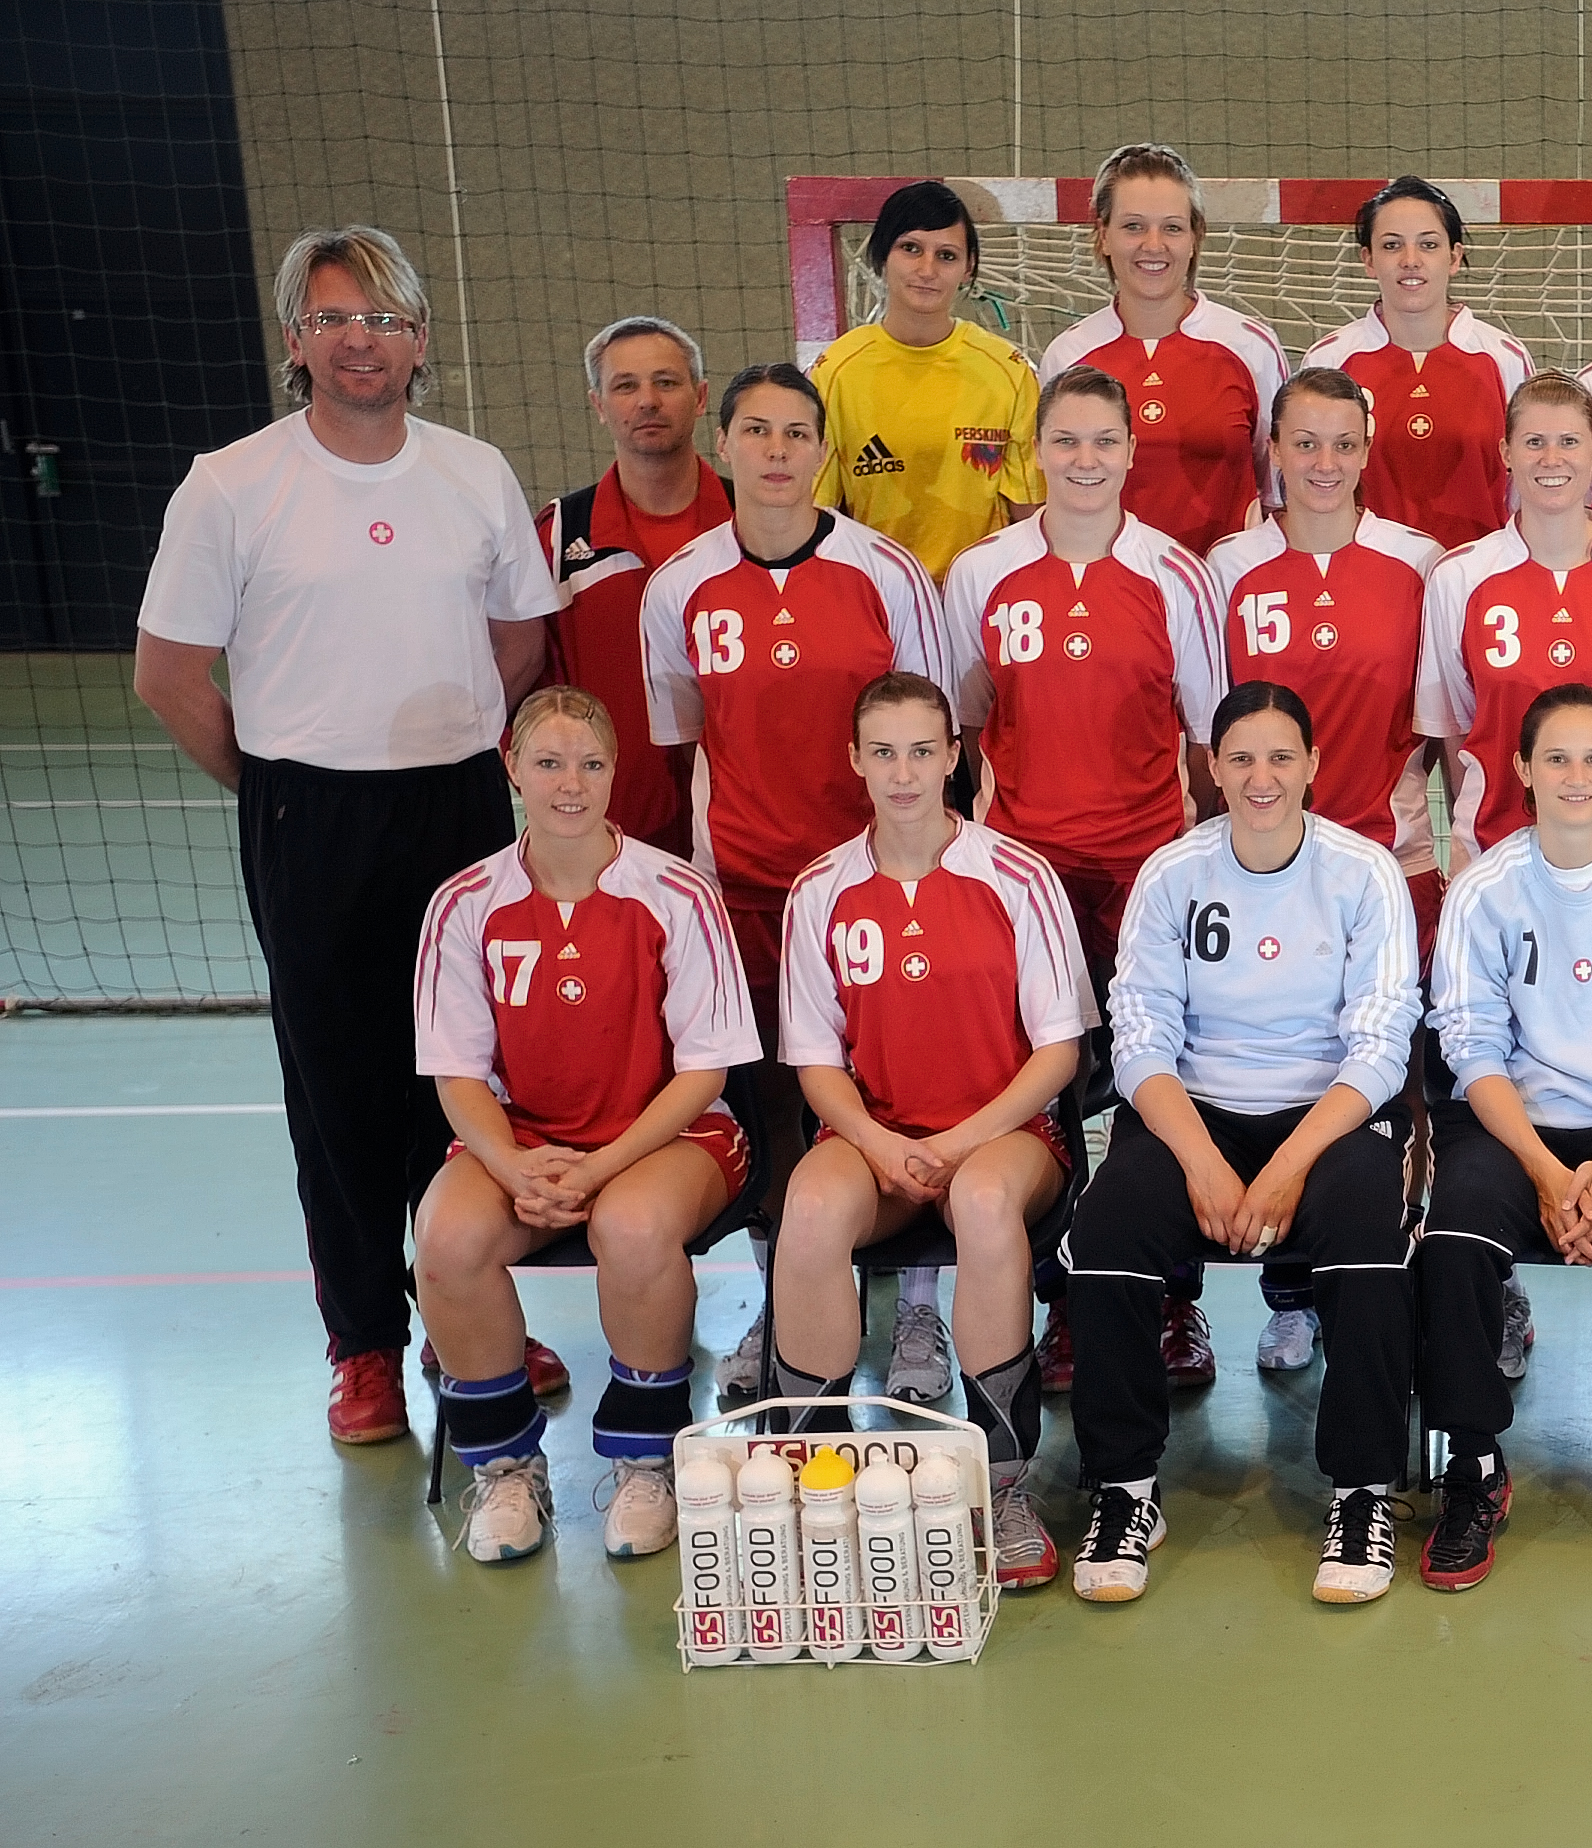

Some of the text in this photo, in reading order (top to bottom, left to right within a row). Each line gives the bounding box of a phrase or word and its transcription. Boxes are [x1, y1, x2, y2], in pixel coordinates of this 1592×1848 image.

[853, 458, 905, 477] adidas
[692, 609, 744, 675] 13
[988, 600, 1043, 666] 18
[1237, 591, 1290, 656] 15
[1484, 604, 1521, 668] 3
[832, 918, 884, 987] 19
[1182, 900, 1230, 962] 16
[486, 940, 541, 1007] 17
